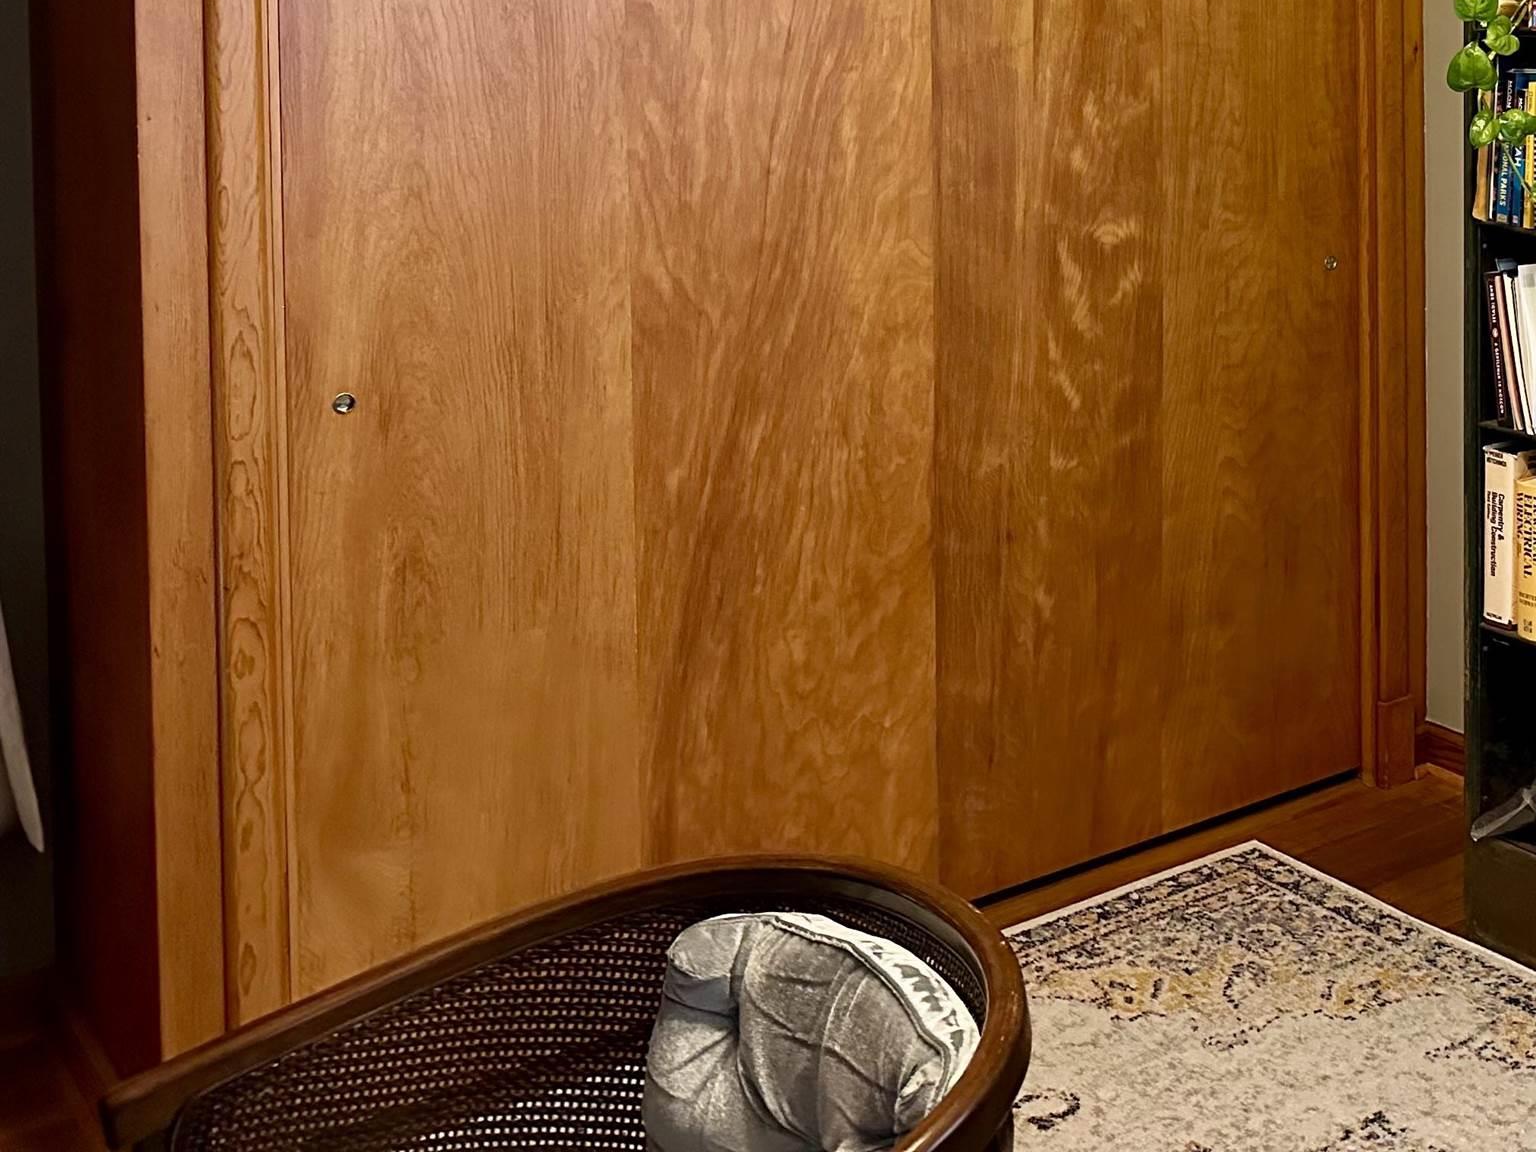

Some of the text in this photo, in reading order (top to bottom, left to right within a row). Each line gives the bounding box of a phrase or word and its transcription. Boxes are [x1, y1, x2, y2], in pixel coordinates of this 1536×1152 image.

[1490, 491, 1498, 576] Building Construction
[1497, 493, 1505, 532] Carpentry
[1516, 491, 1524, 538] WIRING
[1523, 493, 1532, 578] ELECTRICAL
